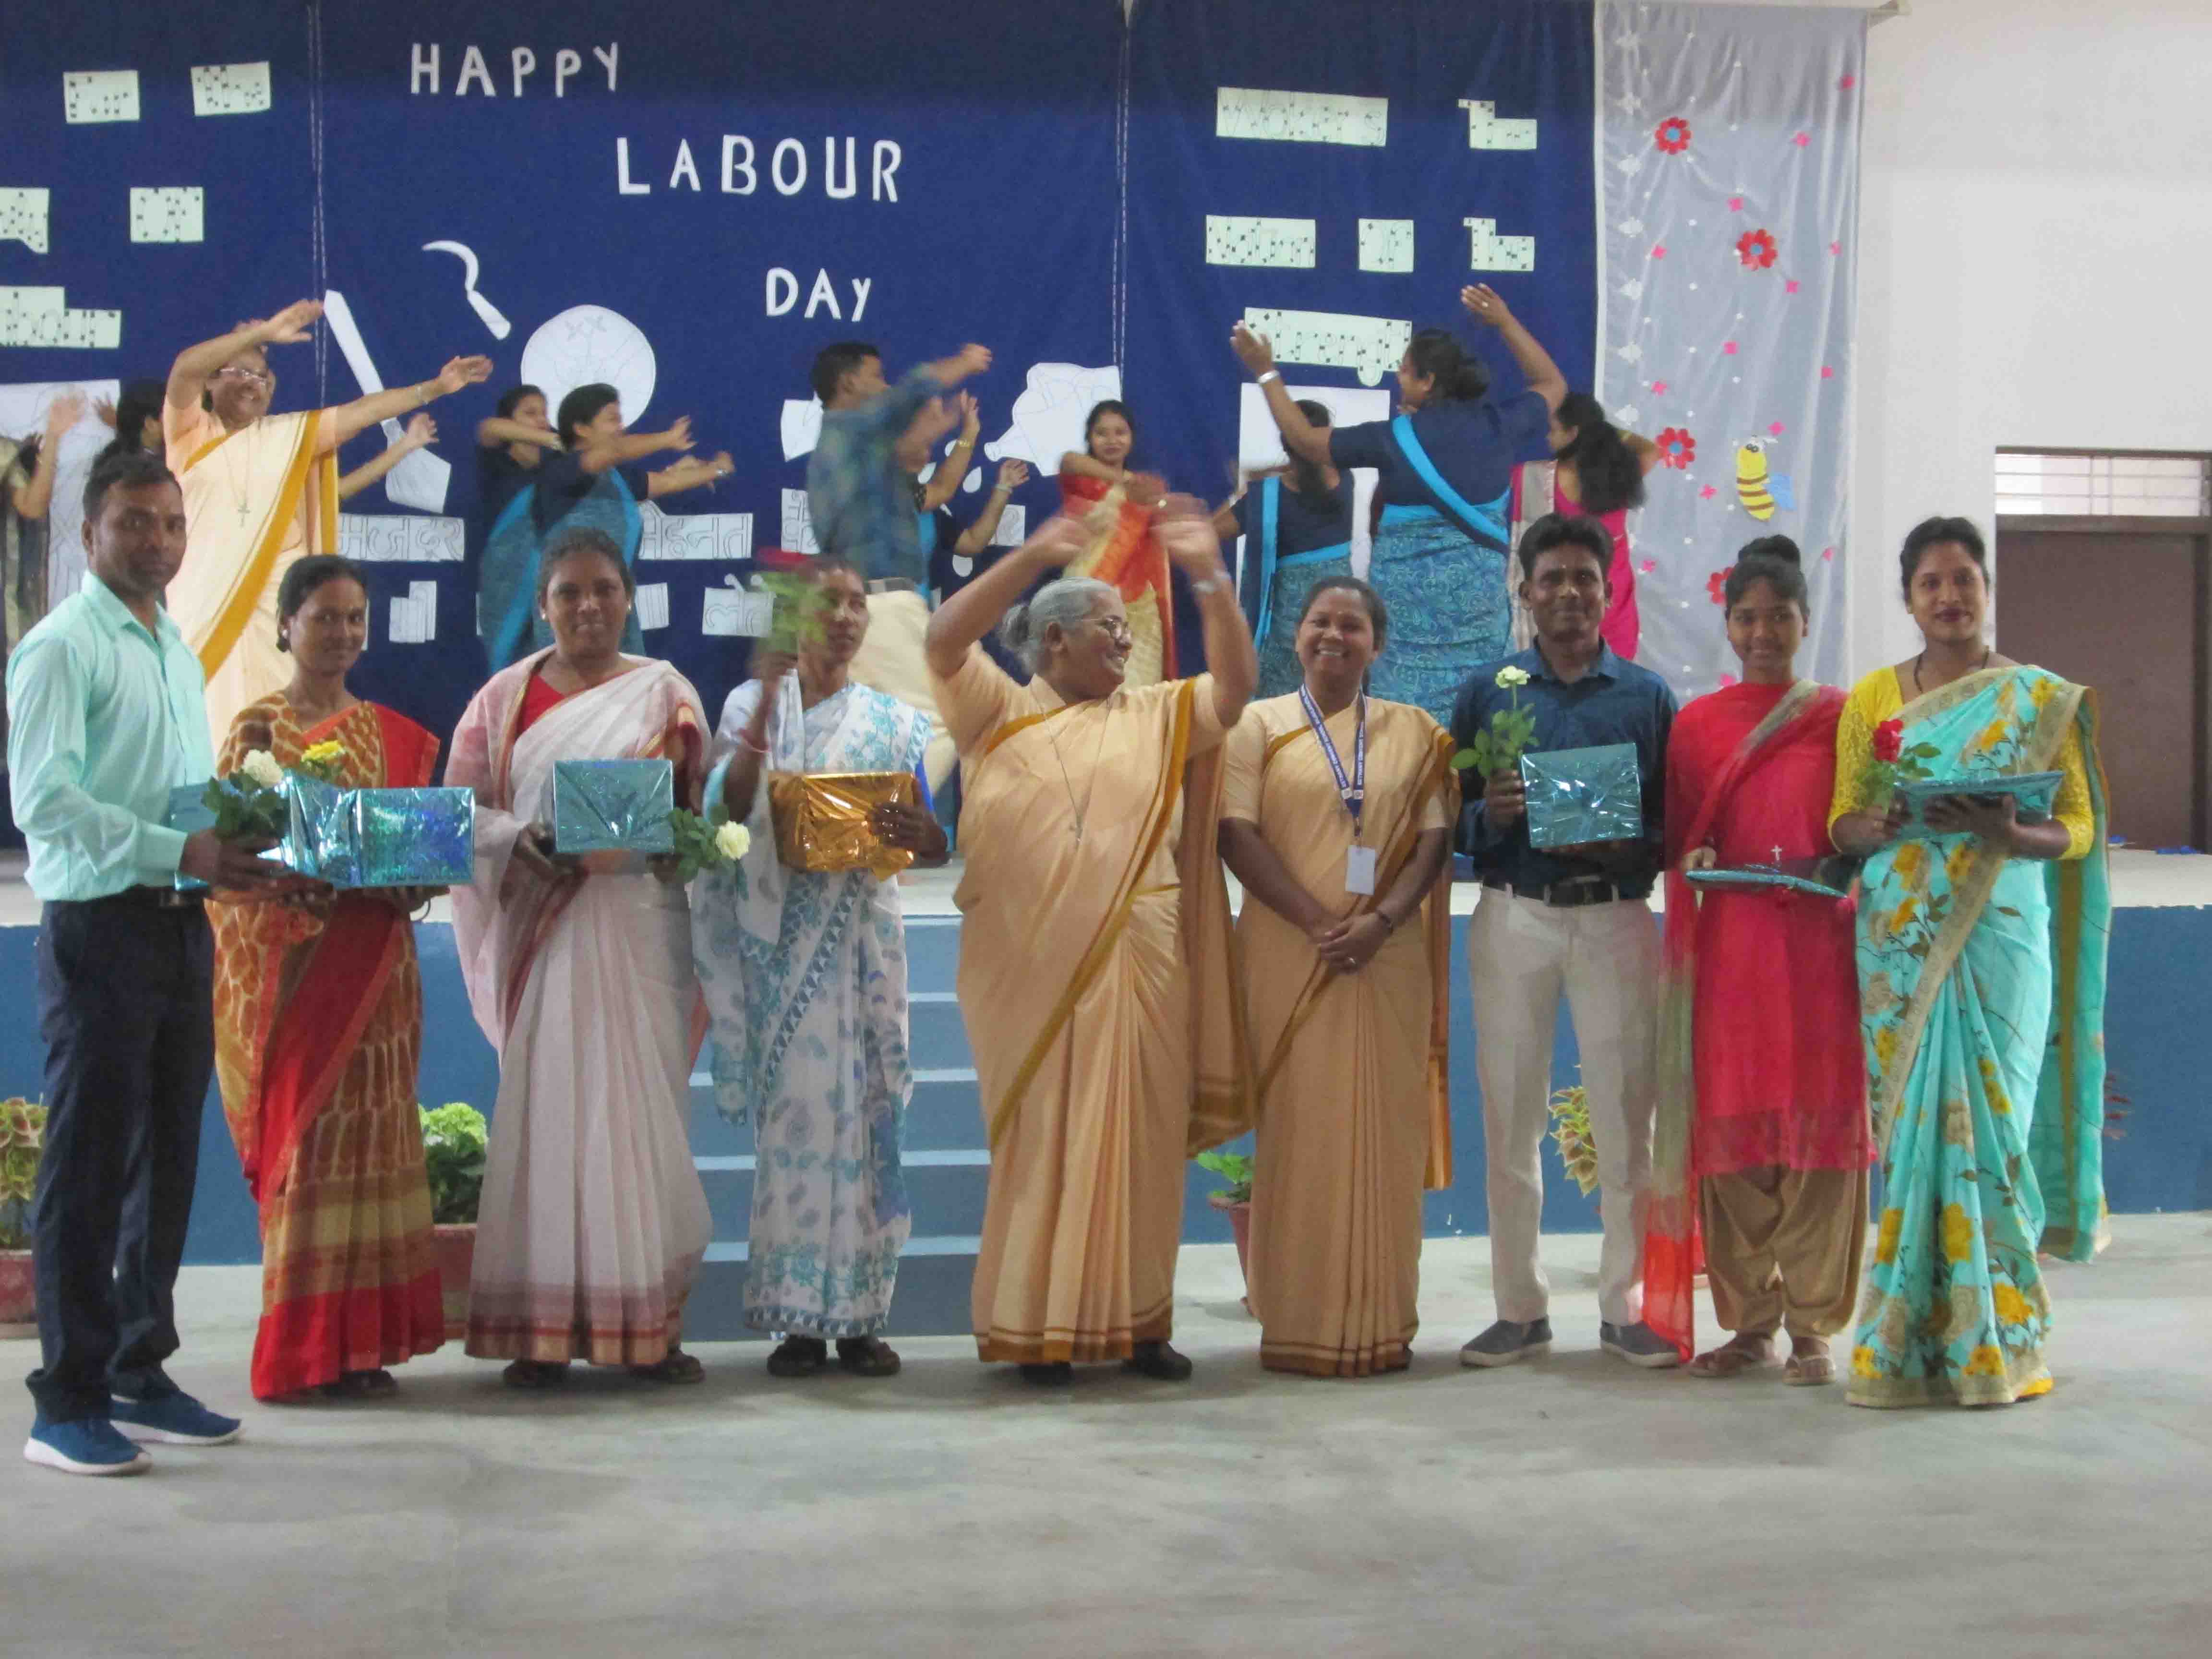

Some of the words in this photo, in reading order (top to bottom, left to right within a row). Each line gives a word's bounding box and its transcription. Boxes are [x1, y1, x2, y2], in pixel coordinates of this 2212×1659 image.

[411, 42, 618, 98] HAPPY
[617, 134, 901, 202] LABOUR
[766, 267, 871, 322] DAY
